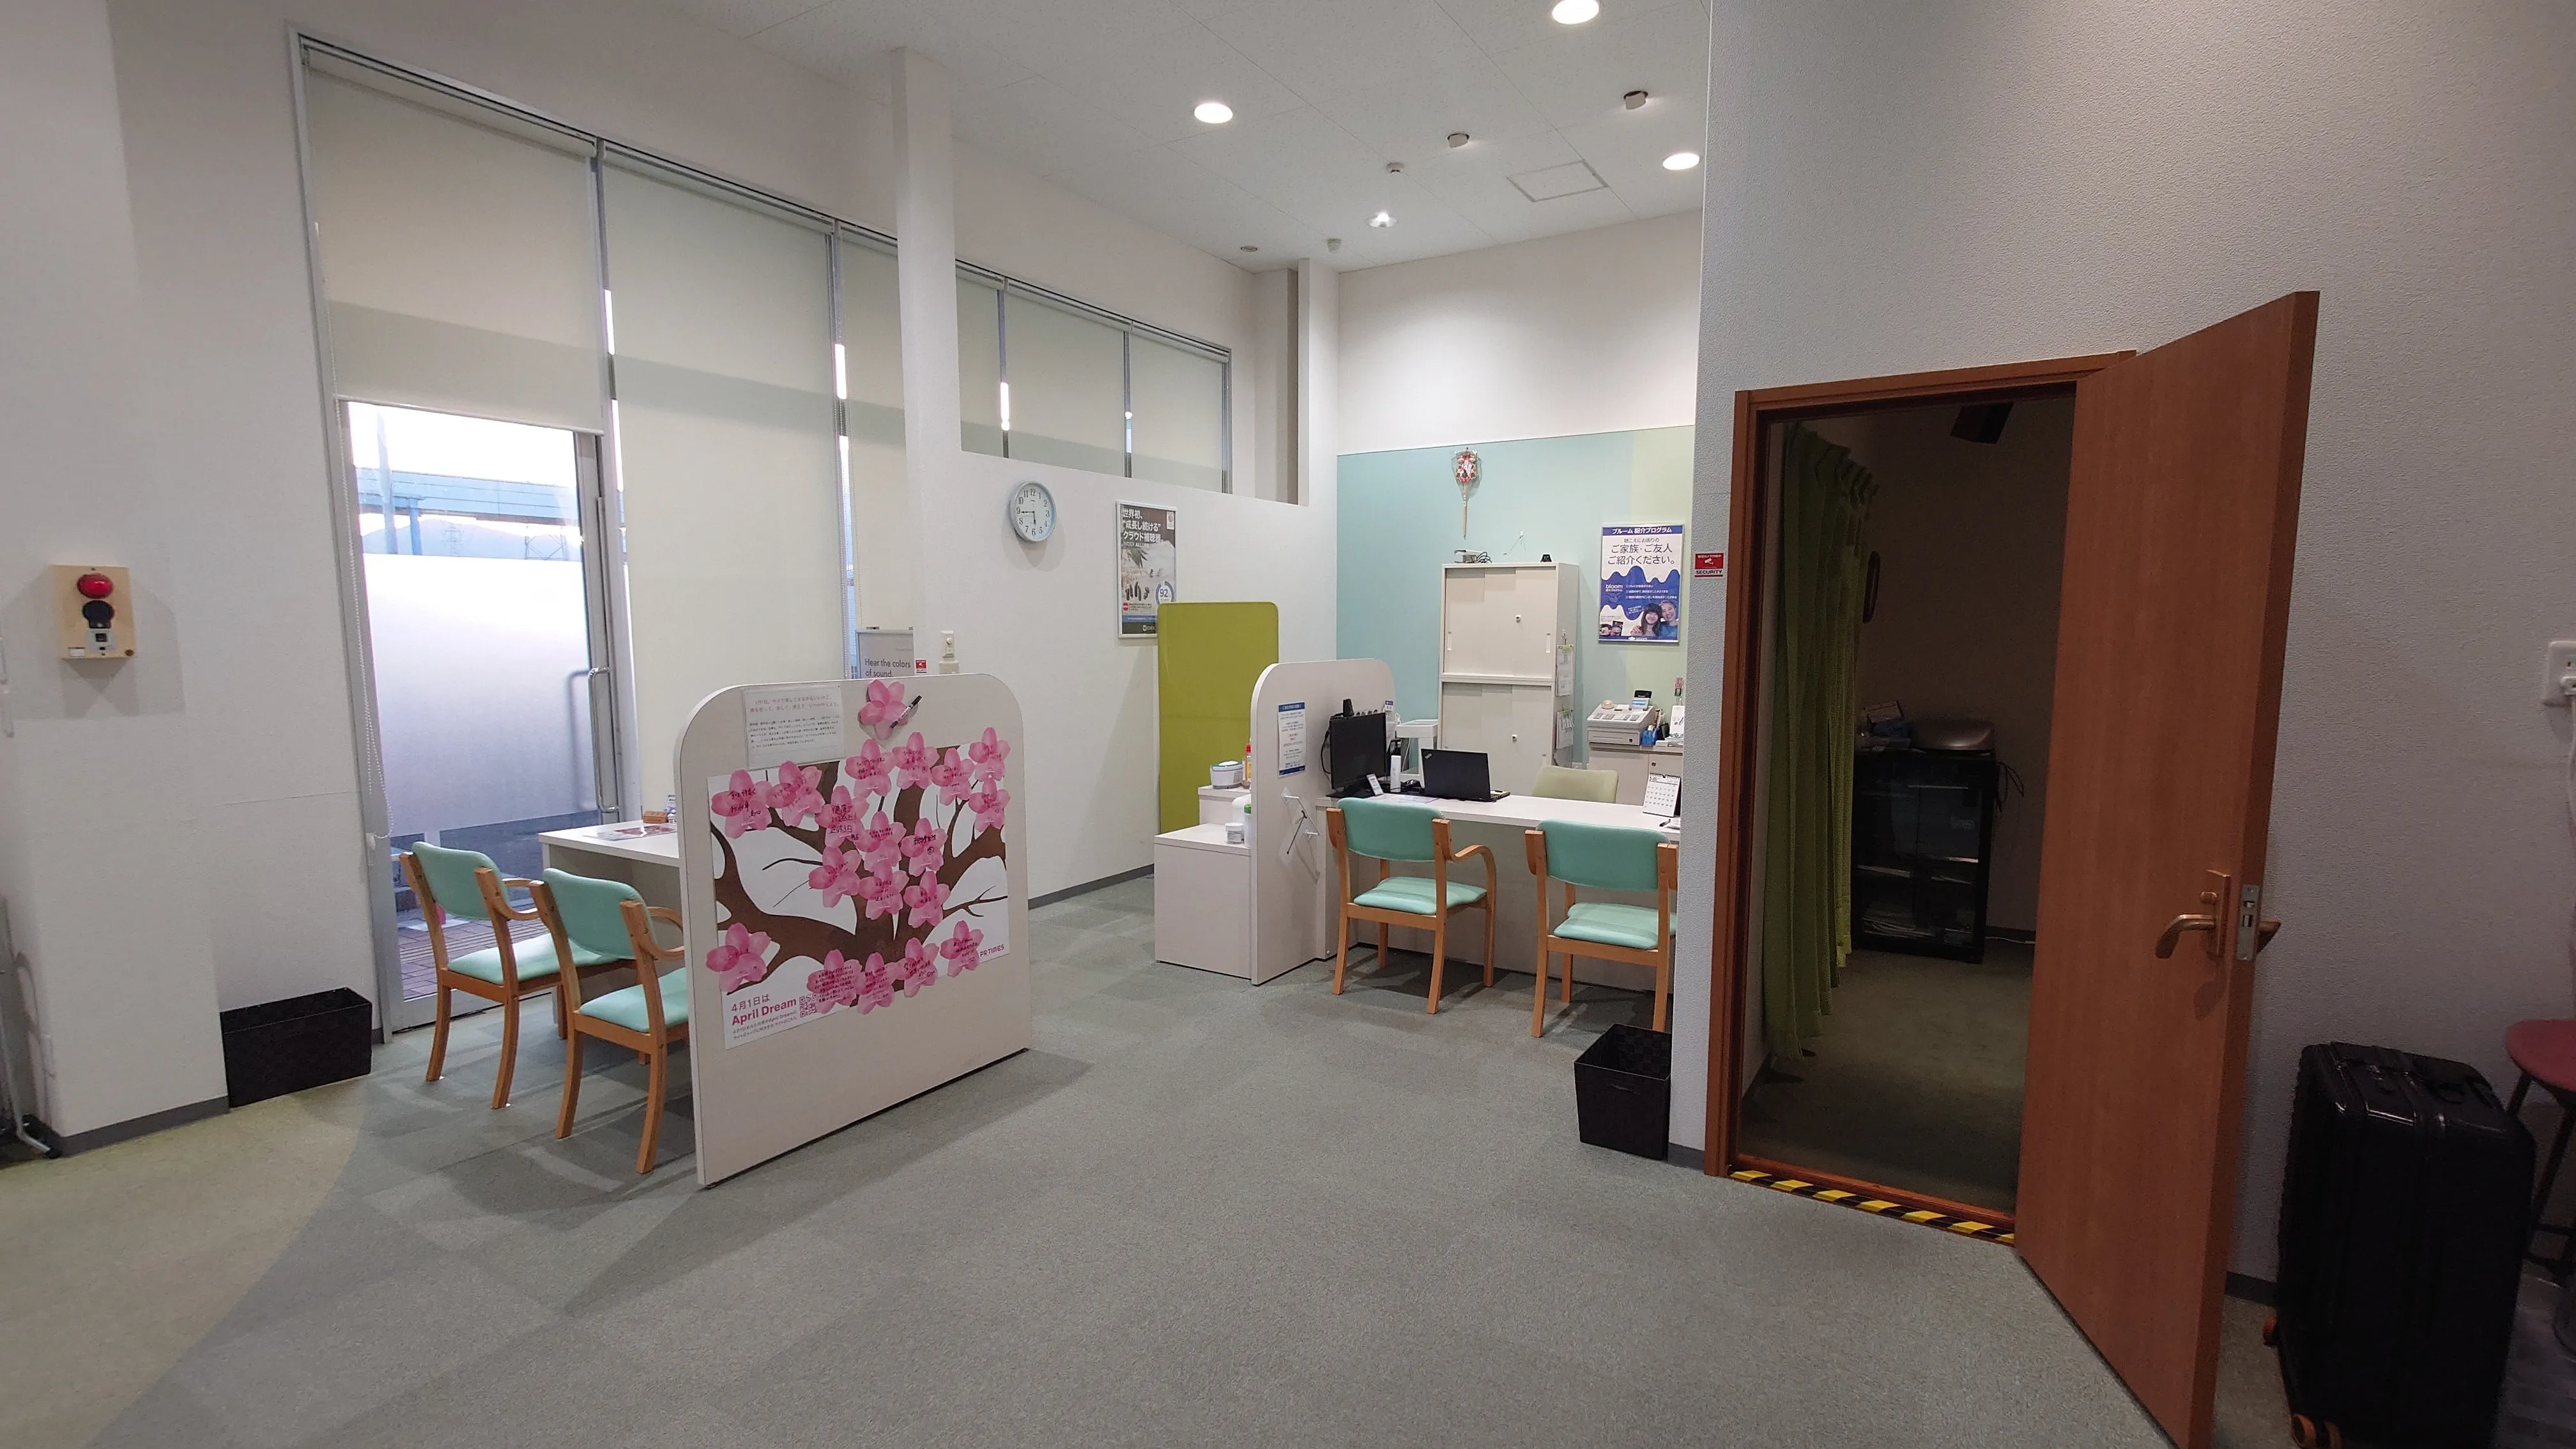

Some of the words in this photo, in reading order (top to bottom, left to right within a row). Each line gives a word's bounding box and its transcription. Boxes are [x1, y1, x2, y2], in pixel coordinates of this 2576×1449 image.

[1123, 508, 1143, 519] 世界初、
[1611, 543, 1673, 554] ご家族・ご友人
[1607, 555, 1675, 565] ご紹介ください。
[864, 658, 880, 667] Hear
[880, 659, 891, 667] the
[892, 659, 911, 668] colors
[866, 668, 872, 677] of
[731, 993, 770, 1012] 4月1日は
[732, 1008, 759, 1026] April
[761, 998, 797, 1016] Dream
